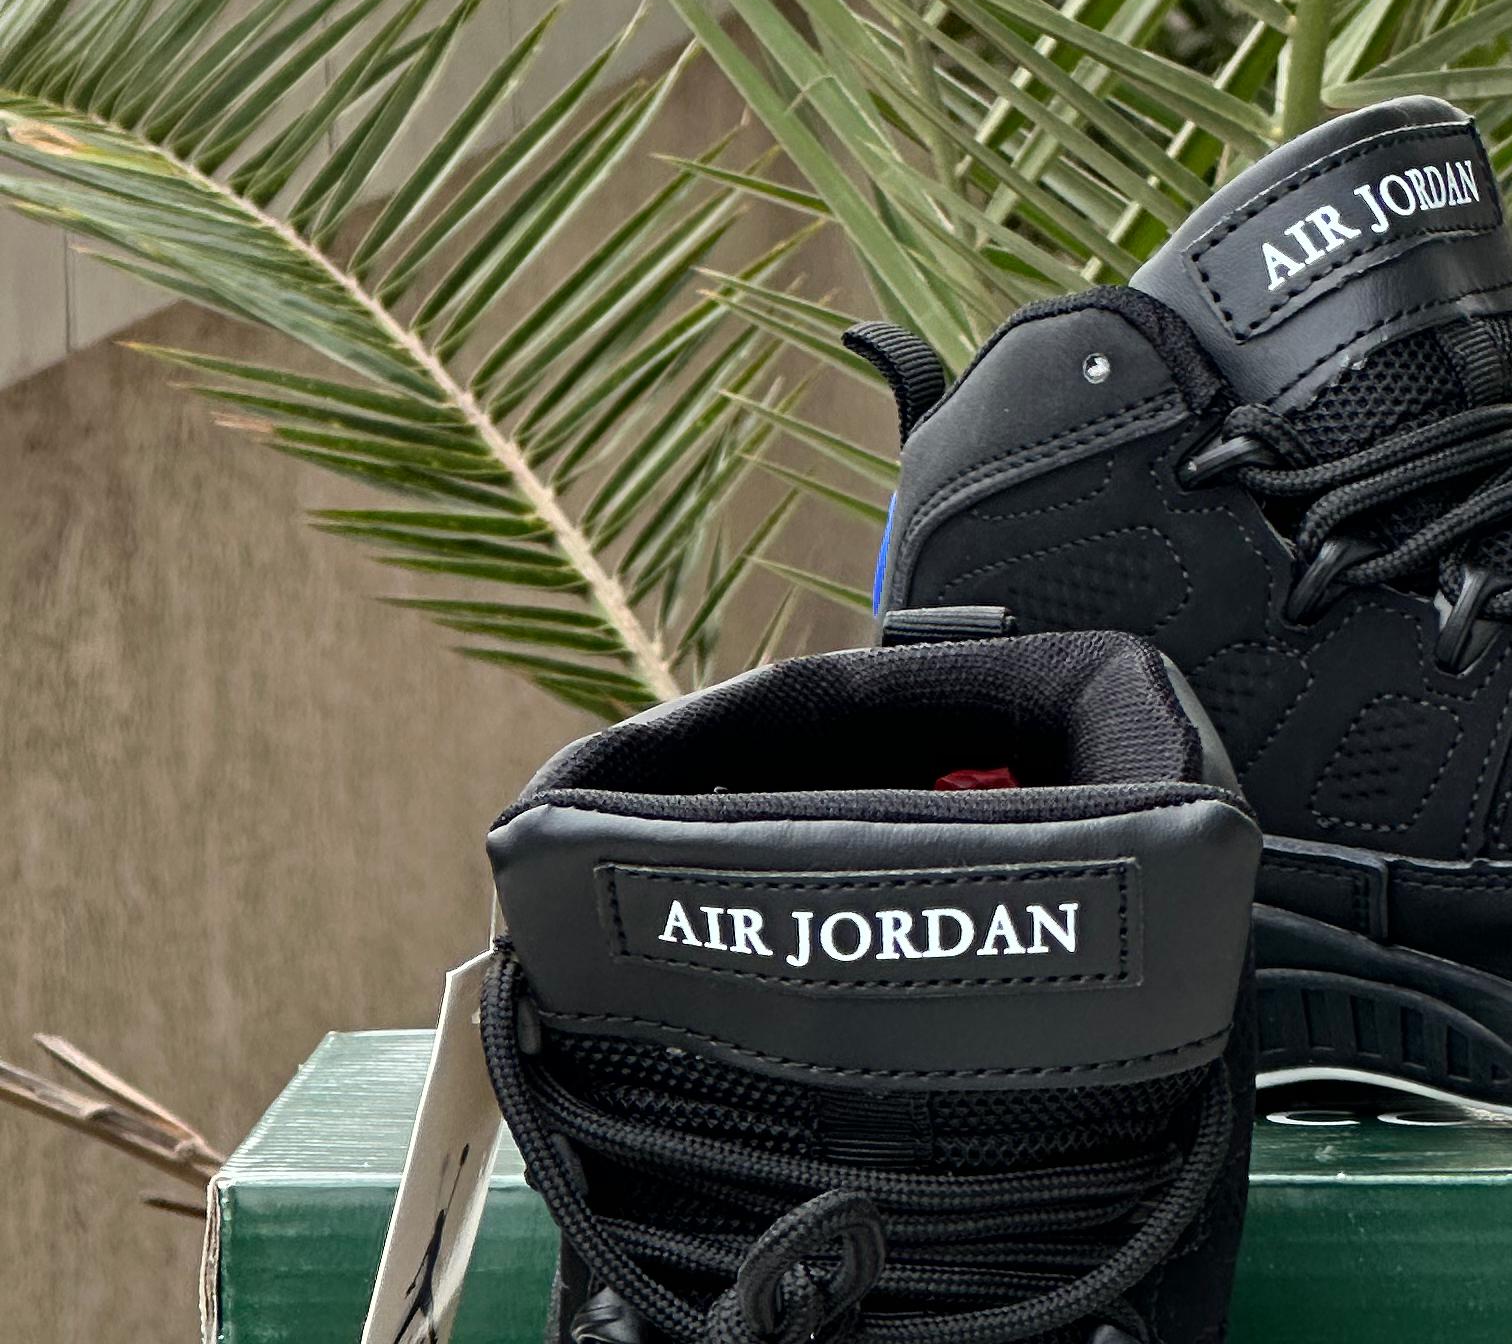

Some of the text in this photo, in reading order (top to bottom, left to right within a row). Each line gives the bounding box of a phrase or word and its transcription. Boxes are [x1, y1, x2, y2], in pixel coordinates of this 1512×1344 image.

[1261, 159, 1480, 291] AIR JORDAN
[658, 899, 1079, 967] AIR JORDAN
